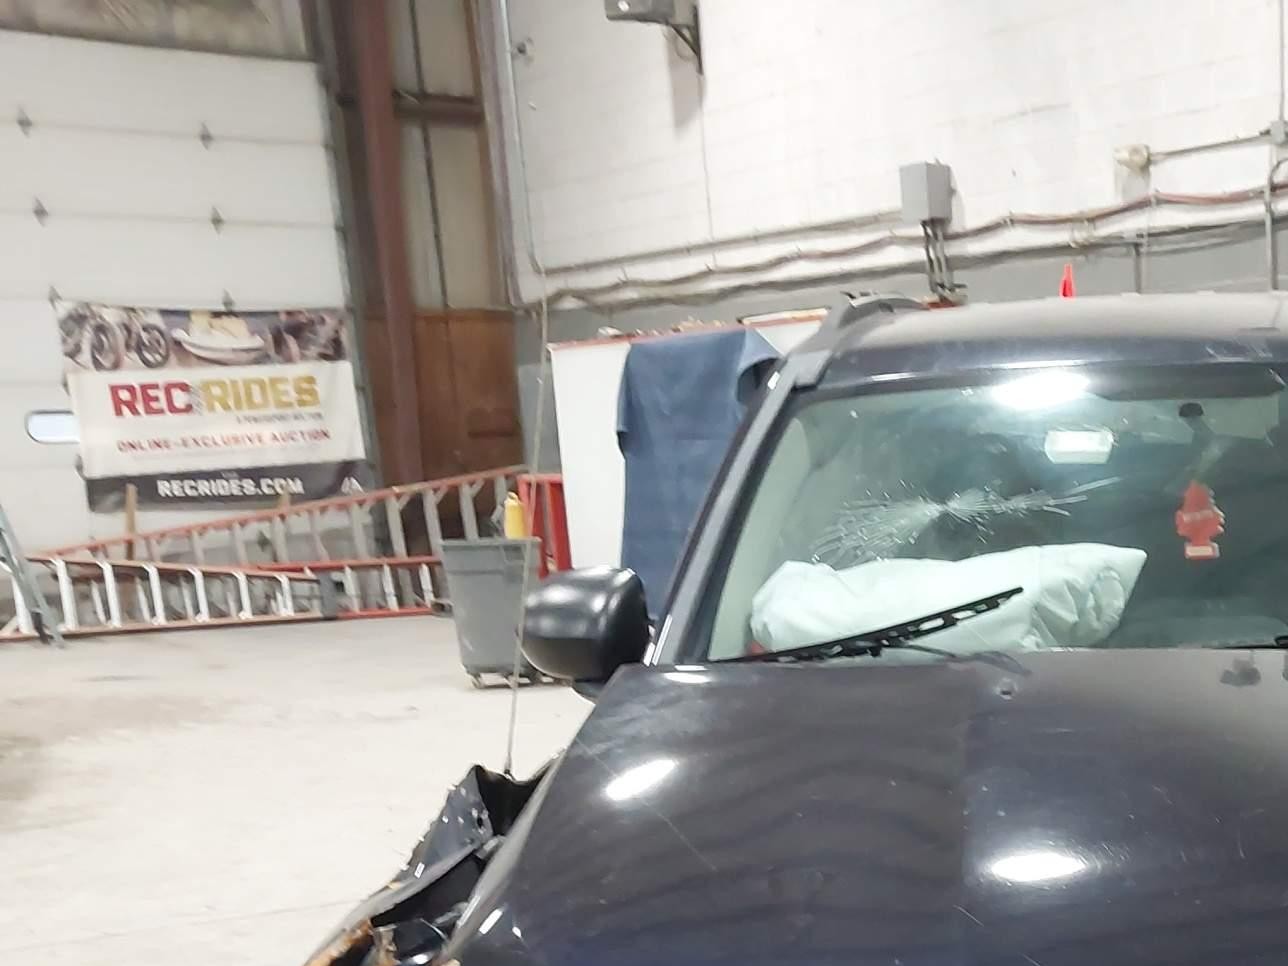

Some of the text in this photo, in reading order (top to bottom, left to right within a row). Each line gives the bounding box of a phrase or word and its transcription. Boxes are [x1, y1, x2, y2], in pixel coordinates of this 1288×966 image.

[108, 375, 321, 417] REC RIDES
[271, 428, 331, 448] AUCTION
[156, 476, 305, 498] RECRIDES.COM
